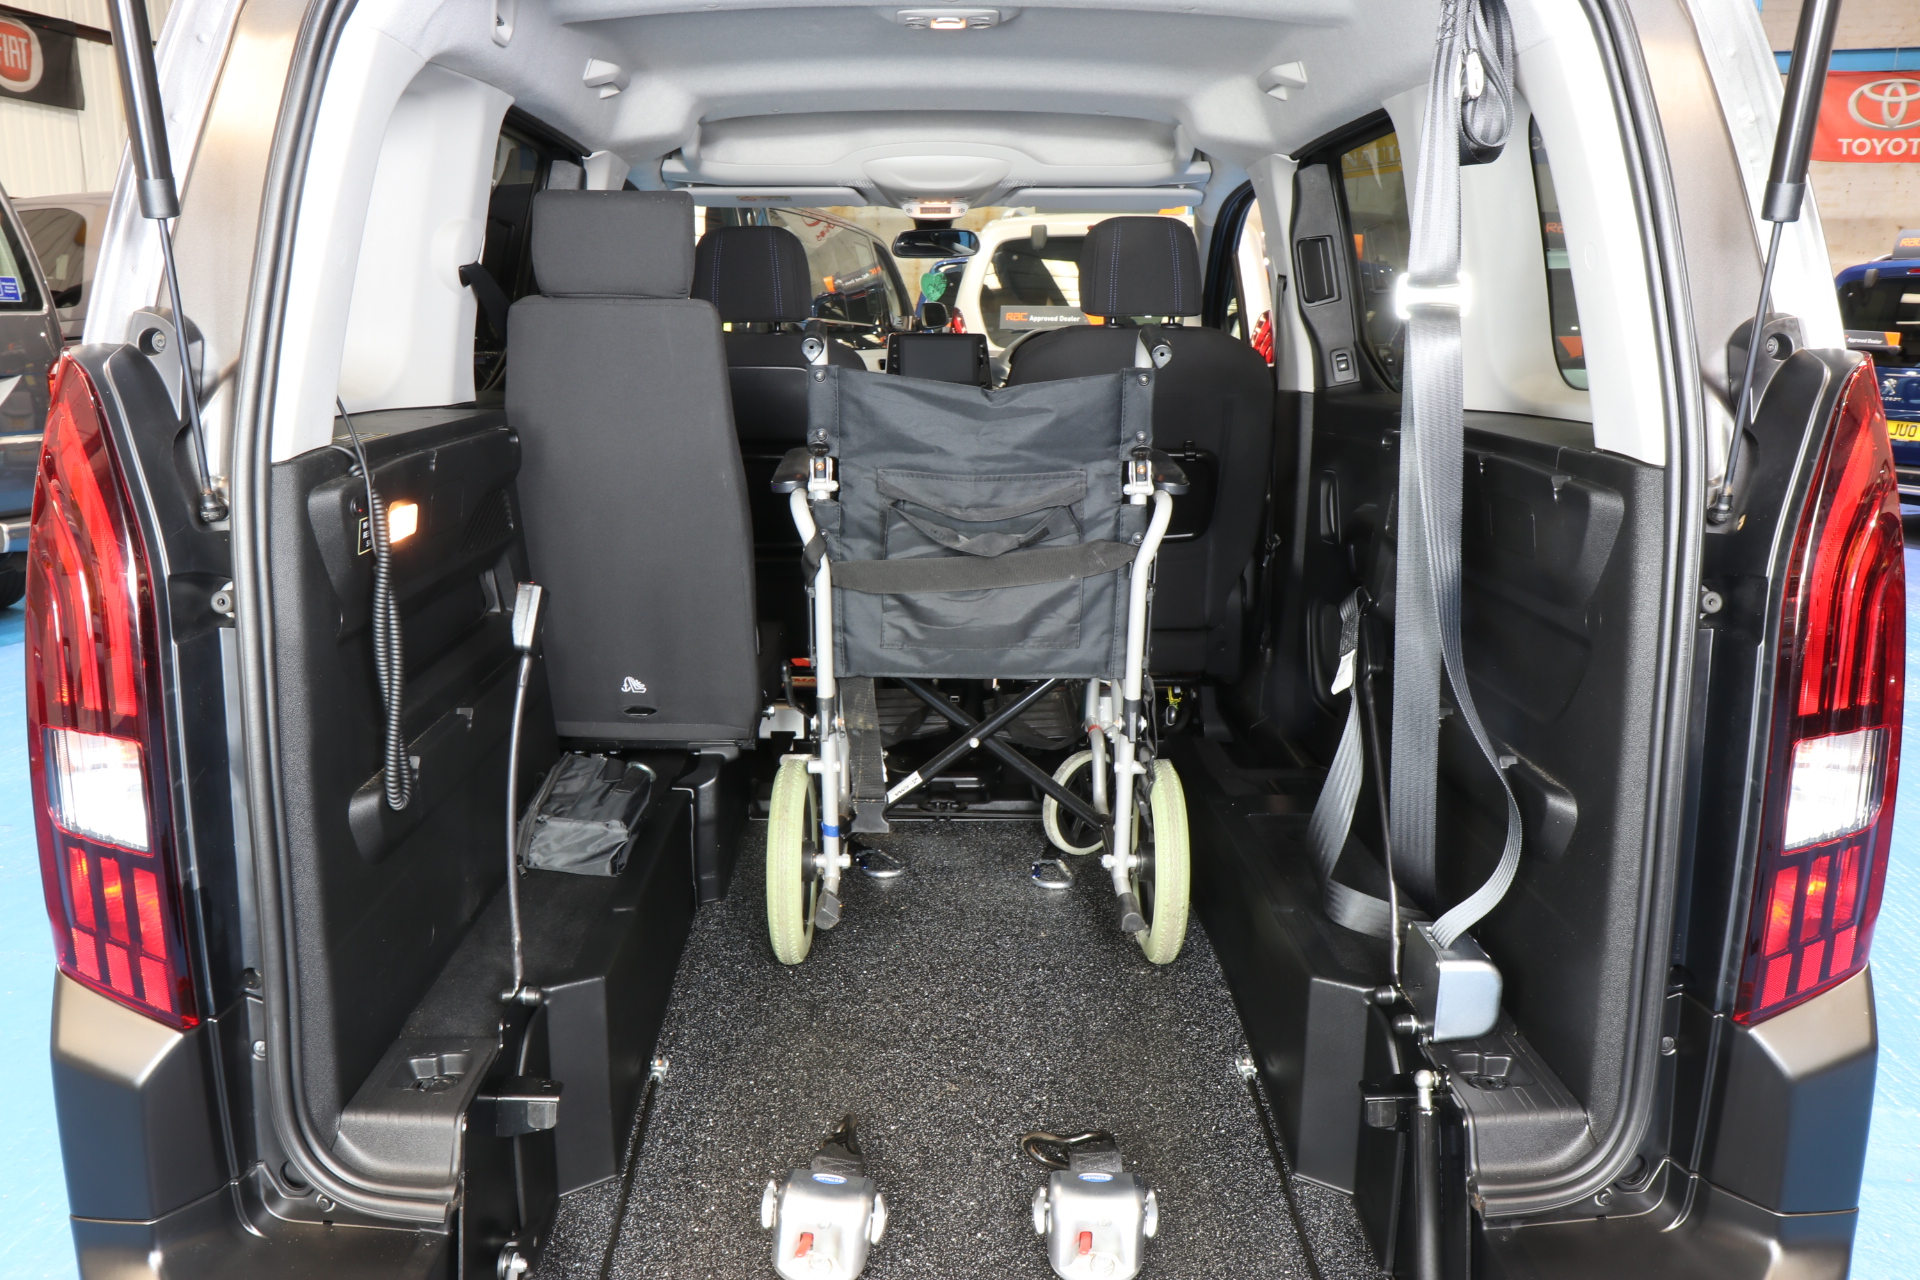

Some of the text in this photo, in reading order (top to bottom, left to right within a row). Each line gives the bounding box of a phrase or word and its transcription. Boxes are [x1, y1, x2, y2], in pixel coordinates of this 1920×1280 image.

[0, 33, 28, 70] IAT
[1341, 144, 1401, 170] NAUL
[1838, 138, 1920, 156] TOYOT
[1029, 315, 1058, 323] Approved
